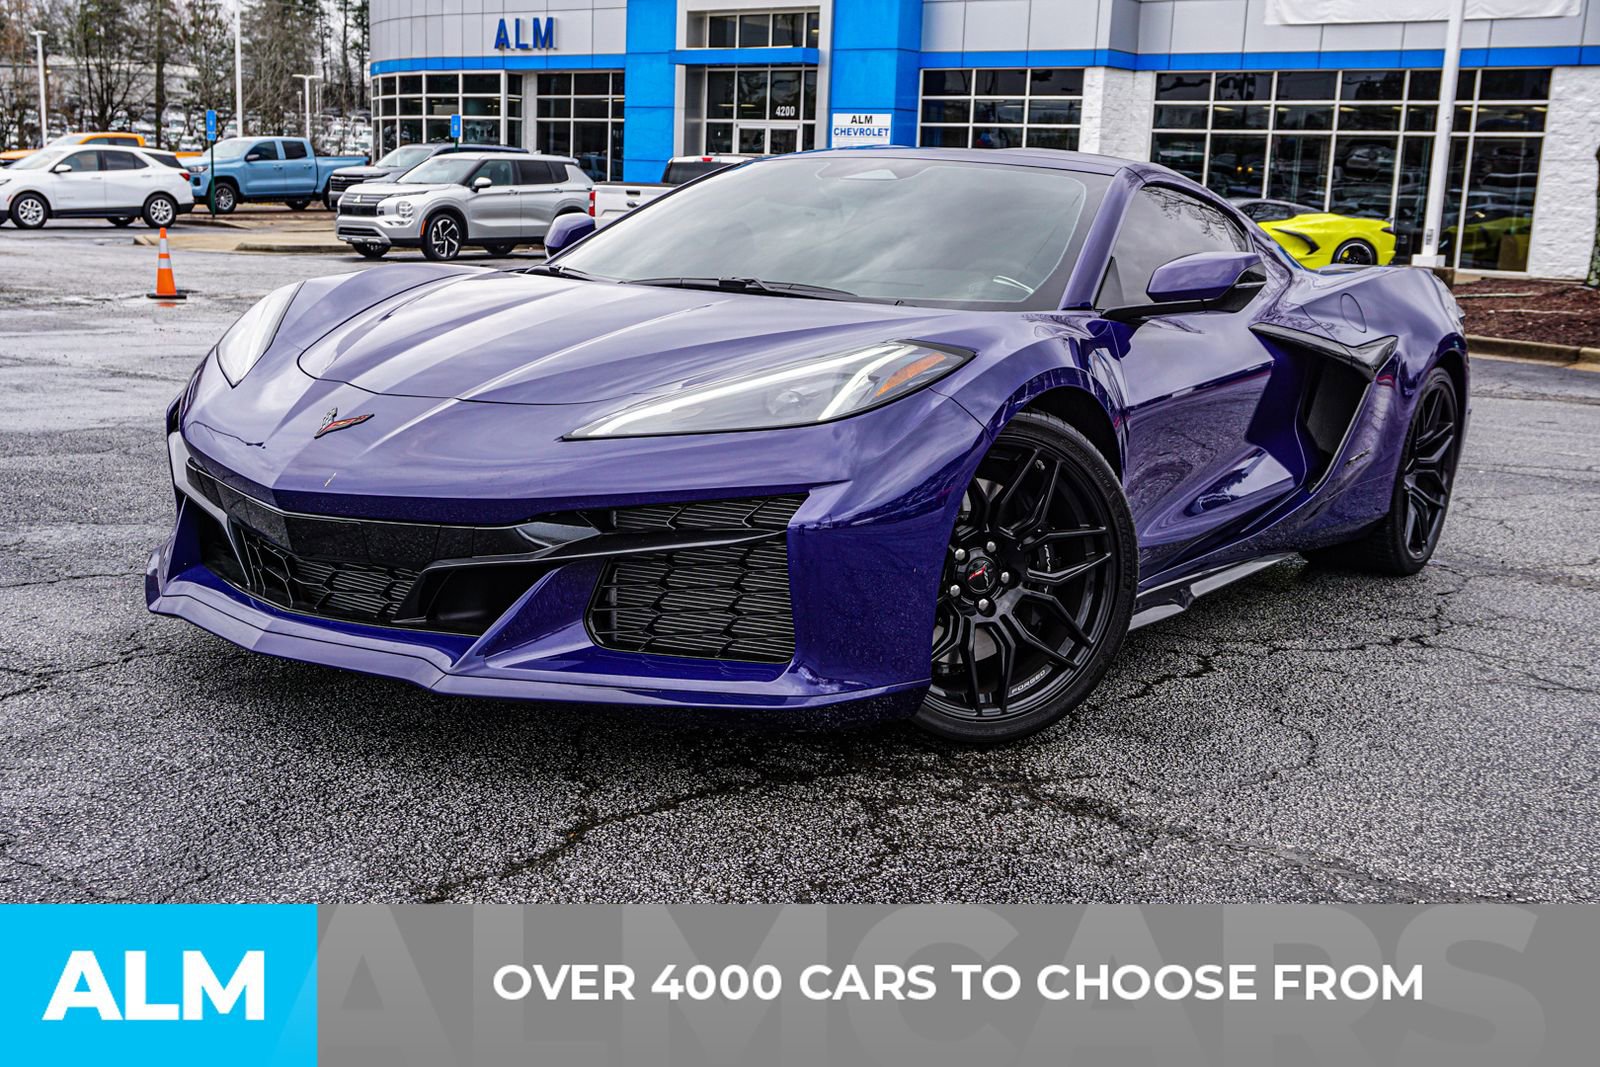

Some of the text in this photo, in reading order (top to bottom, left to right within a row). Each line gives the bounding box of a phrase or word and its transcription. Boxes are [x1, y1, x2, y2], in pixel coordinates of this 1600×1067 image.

[494, 17, 557, 50] ALM
[775, 106, 796, 117] 4200
[850, 115, 873, 125] ALM
[833, 127, 889, 137] CHEVROLET
[1011, 669, 1046, 694] FORGED
